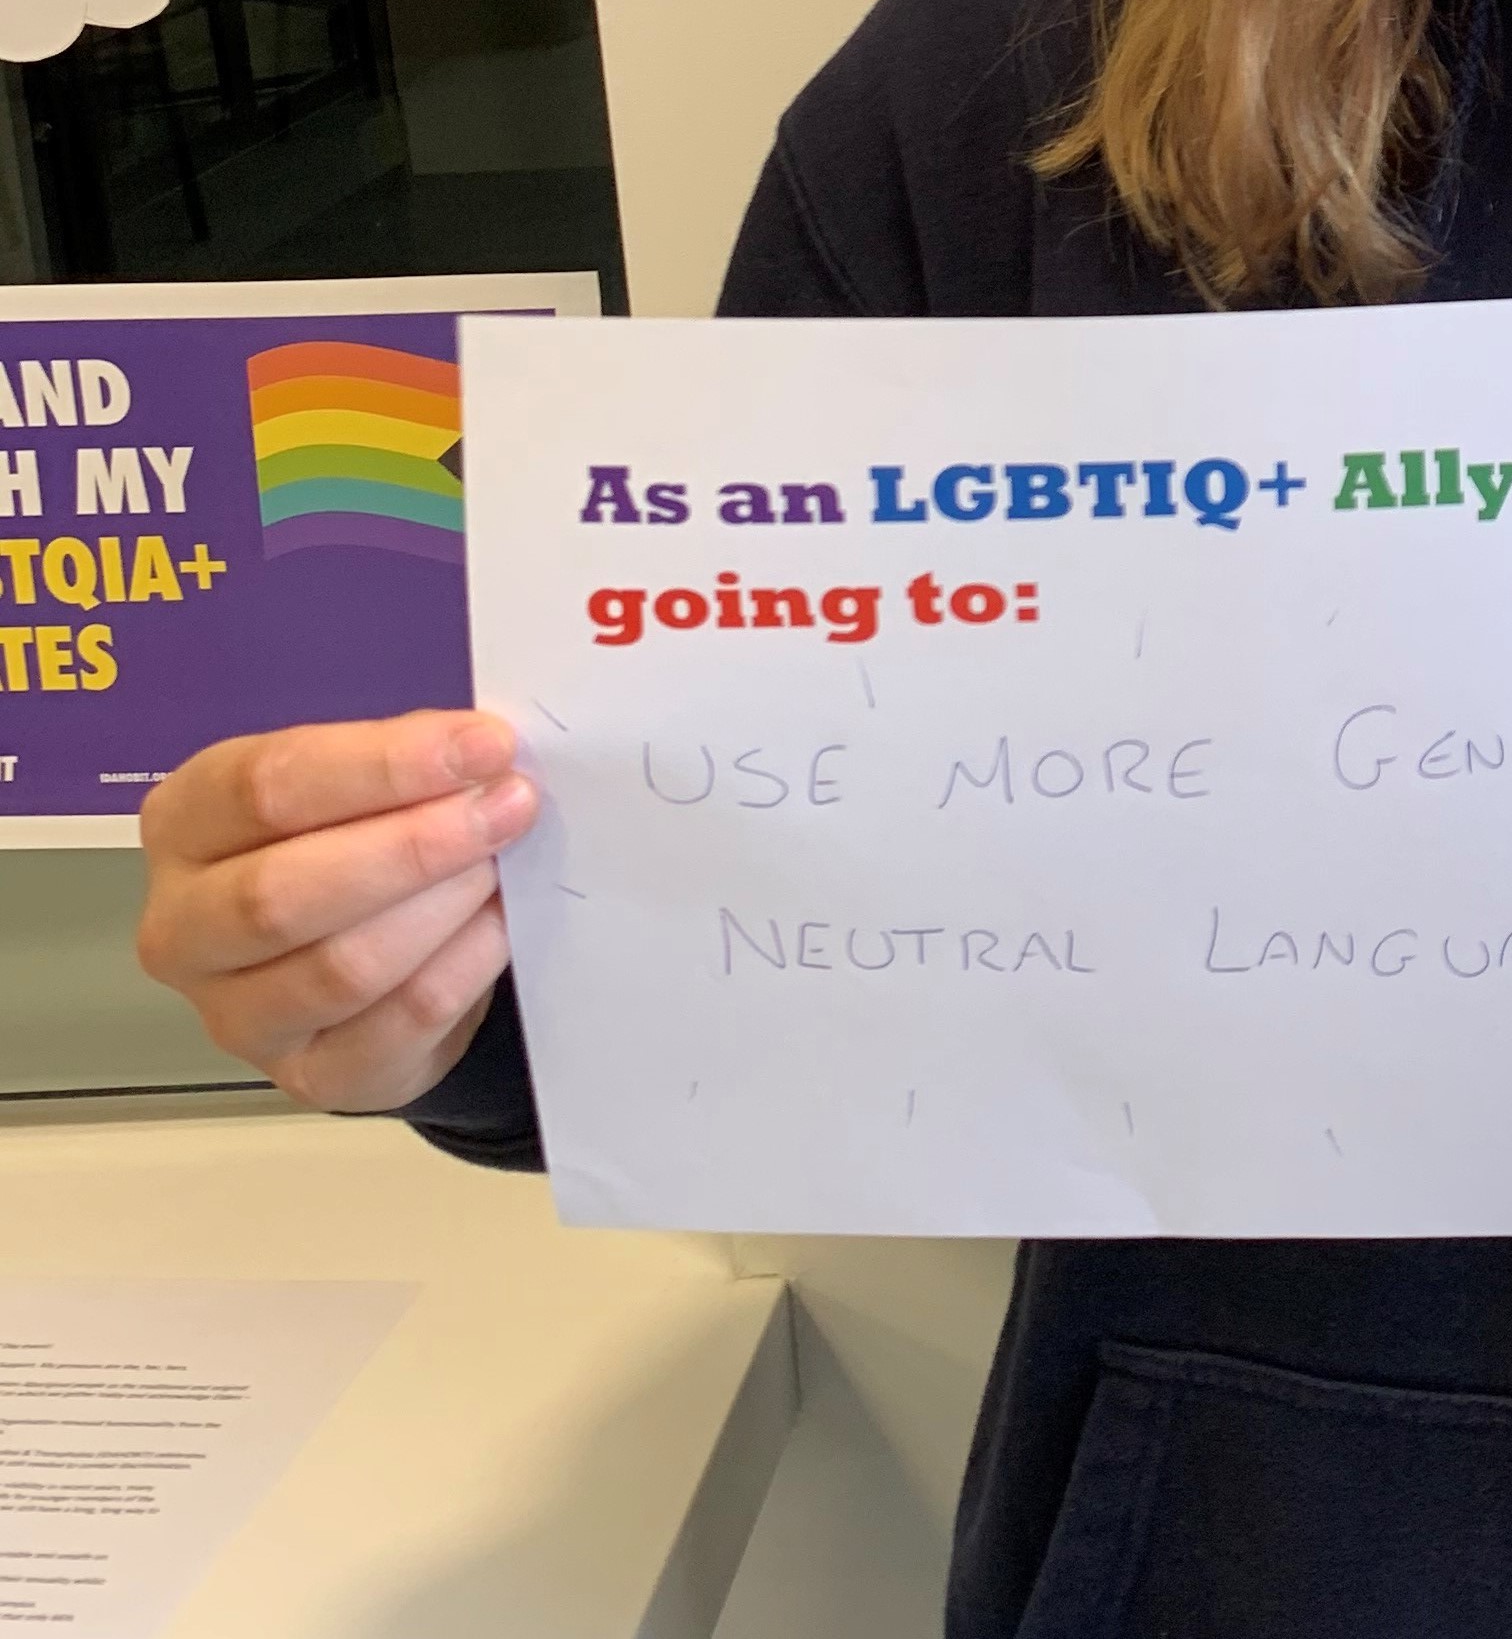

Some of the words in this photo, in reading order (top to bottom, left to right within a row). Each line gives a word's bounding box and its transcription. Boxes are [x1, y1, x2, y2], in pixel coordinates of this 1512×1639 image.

[76, 446, 194, 516] MY
[579, 465, 692, 526] As
[717, 482, 846, 526] an
[869, 457, 1307, 532] LGBTIQ+
[0, 535, 227, 611] TQIA+
[586, 571, 882, 647] going
[906, 571, 1040, 626] to:
[0, 623, 118, 692] TES
[642, 740, 848, 809] USE
[937, 735, 1213, 810] MORE
[718, 906, 1097, 976] NEUTRAL
